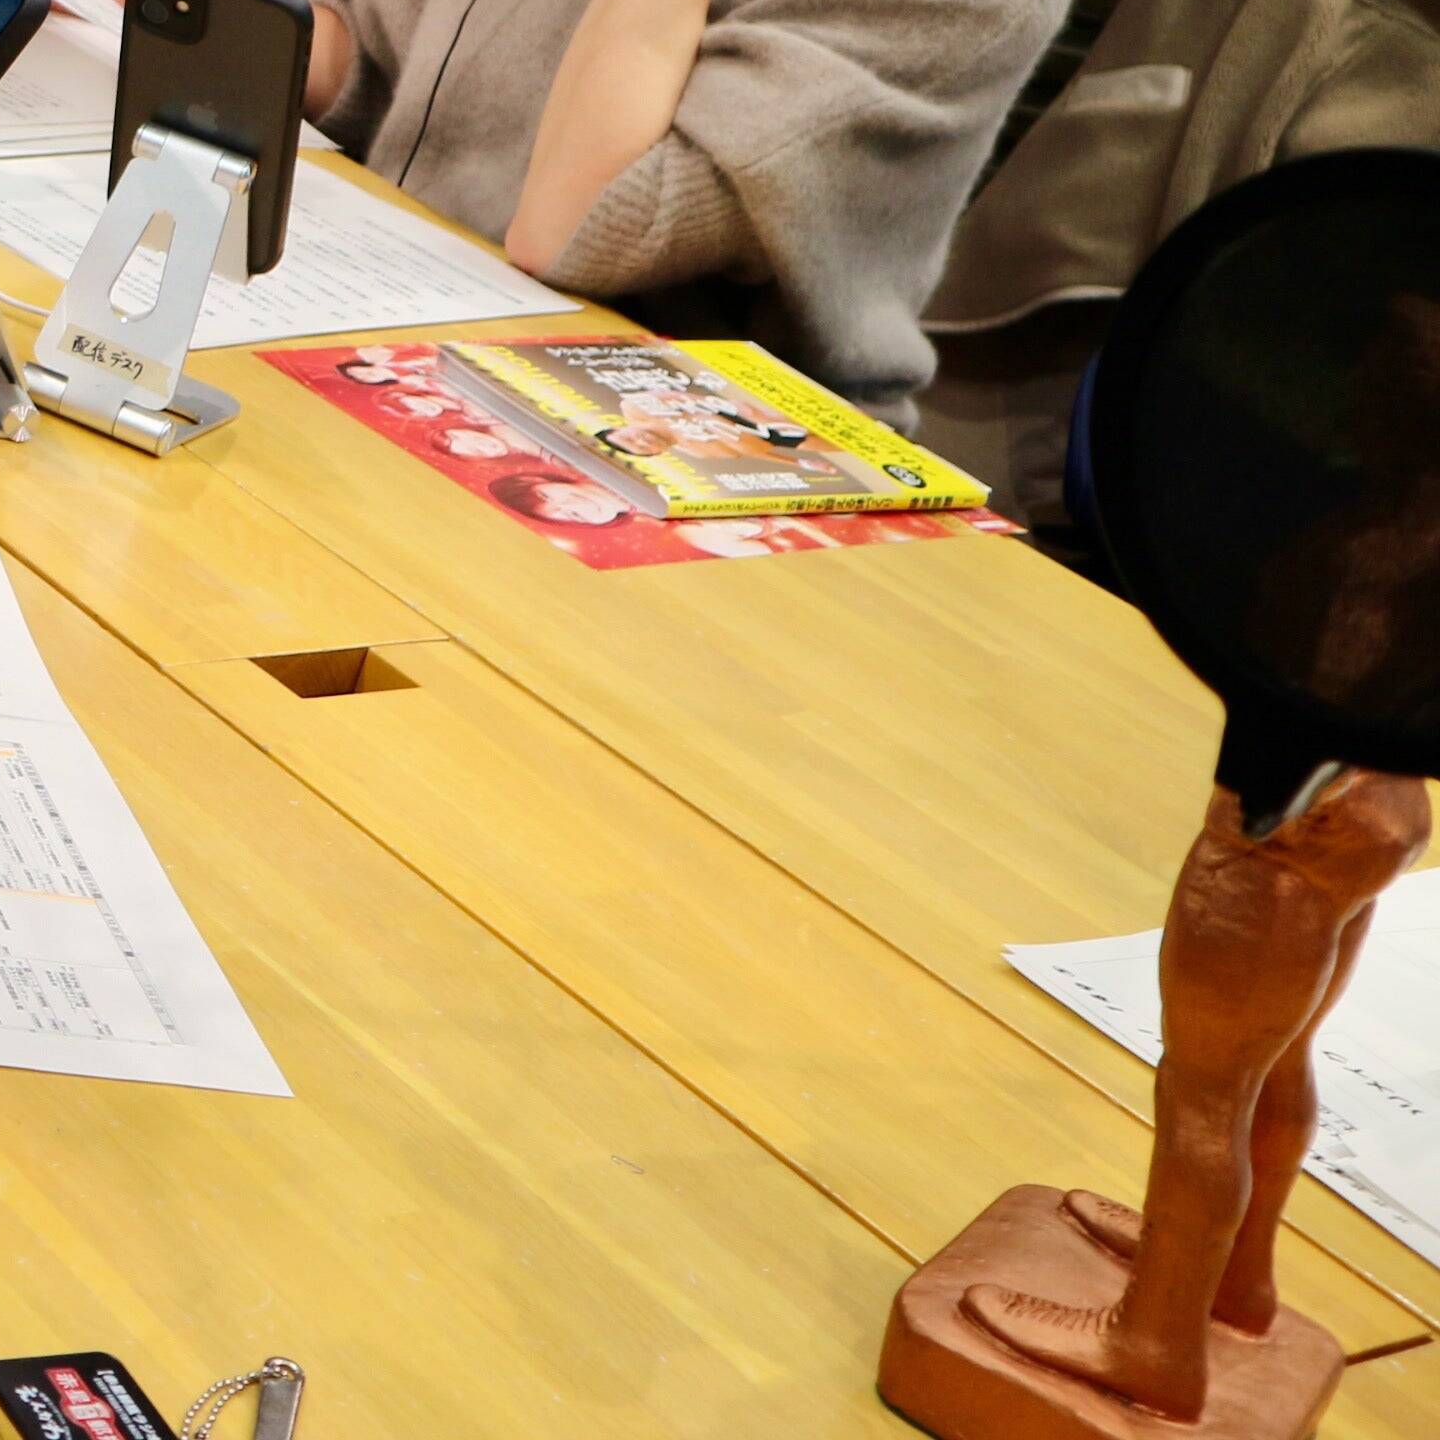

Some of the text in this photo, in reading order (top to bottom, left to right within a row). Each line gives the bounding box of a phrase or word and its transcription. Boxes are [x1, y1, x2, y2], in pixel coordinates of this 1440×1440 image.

[71, 335, 144, 380] 配信デスク
